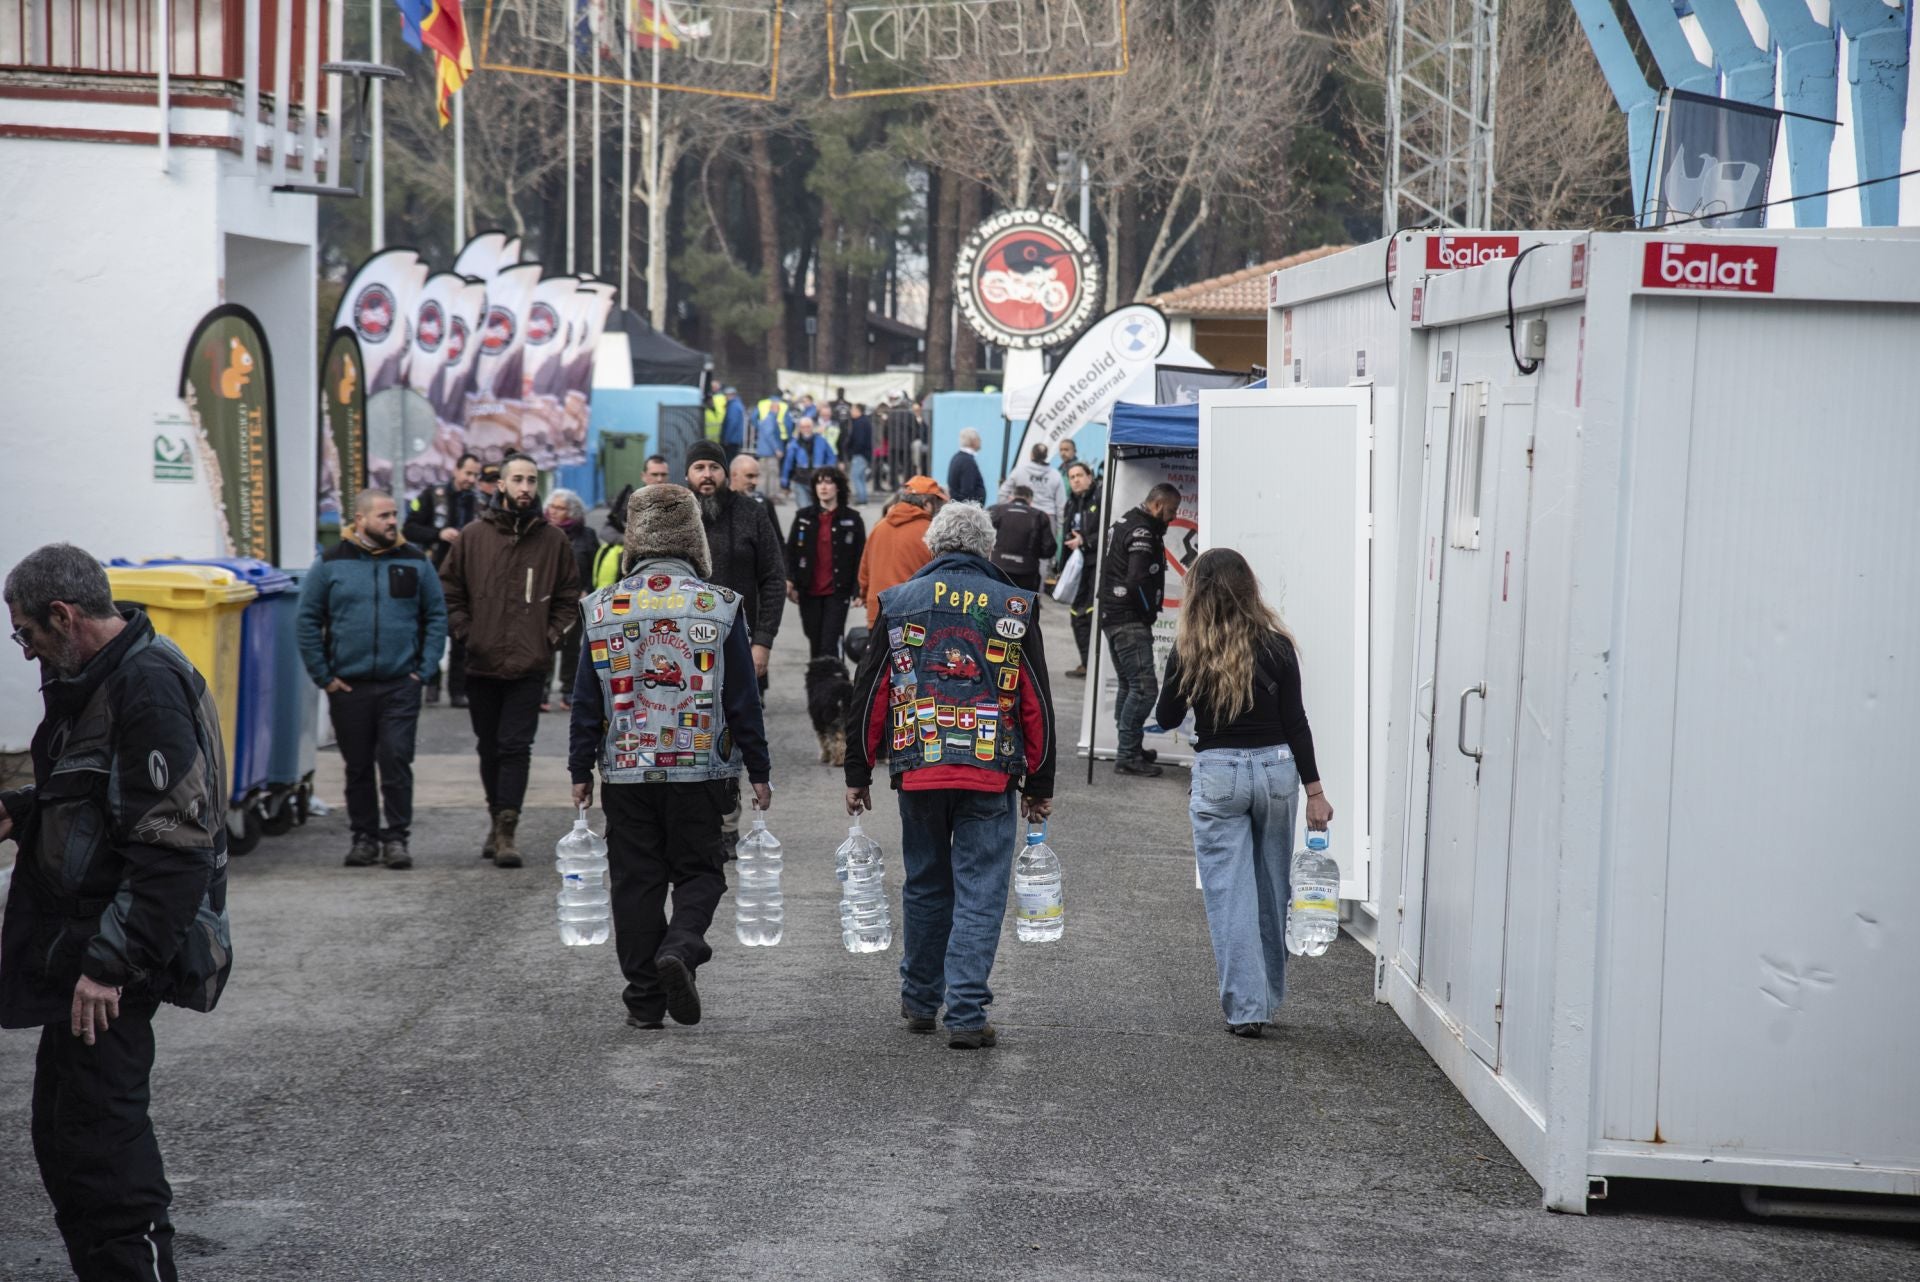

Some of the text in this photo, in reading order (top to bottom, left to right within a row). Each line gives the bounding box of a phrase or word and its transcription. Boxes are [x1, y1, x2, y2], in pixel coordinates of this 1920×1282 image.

[979, 210, 1088, 253] MOTO CLUB
[1660, 243, 1759, 286] balat
[956, 278, 1025, 348] LEYENDA
[1028, 263, 1097, 347] CONTINUA
[1034, 350, 1117, 432] Fuenteolid
[1049, 368, 1127, 442] BMW Motorrad
[934, 581, 989, 614] Pepe
[695, 626, 711, 639] NL
[1002, 620, 1018, 635] NL
